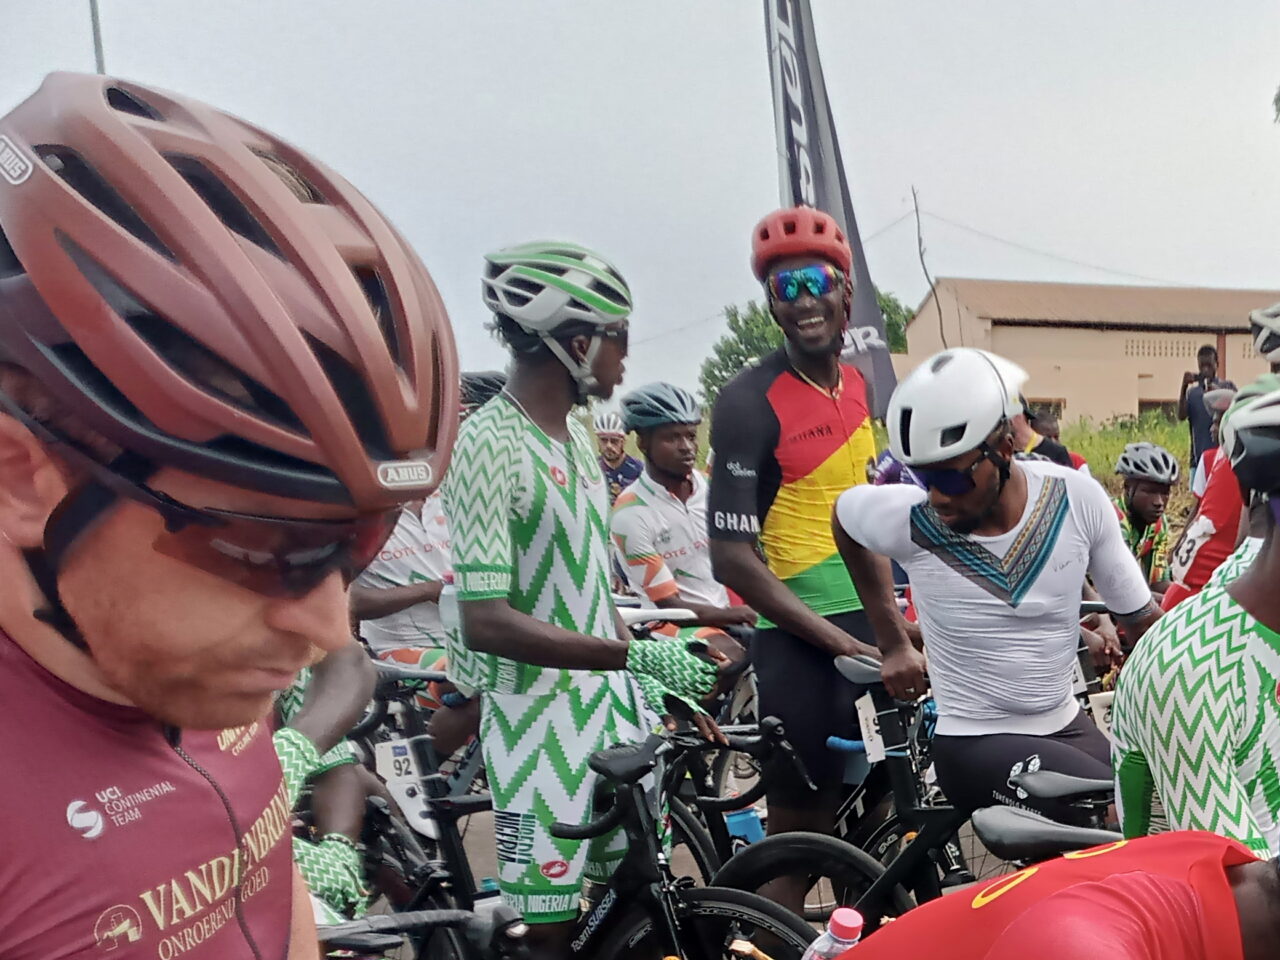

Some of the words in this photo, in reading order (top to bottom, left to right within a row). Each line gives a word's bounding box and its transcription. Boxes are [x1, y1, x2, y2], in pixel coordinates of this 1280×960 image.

[0, 141, 27, 178] BUS
[386, 466, 427, 482] ABUS
[393, 757, 412, 777] 92
[96, 786, 122, 804] UCI
[104, 781, 176, 816] CONTINENTAL
[110, 807, 142, 828] TEAM
[494, 810, 521, 863] NIGERIA
[518, 813, 536, 864] NIGERIA
[240, 866, 270, 902] GOED
[527, 893, 570, 913] NIGERIA
